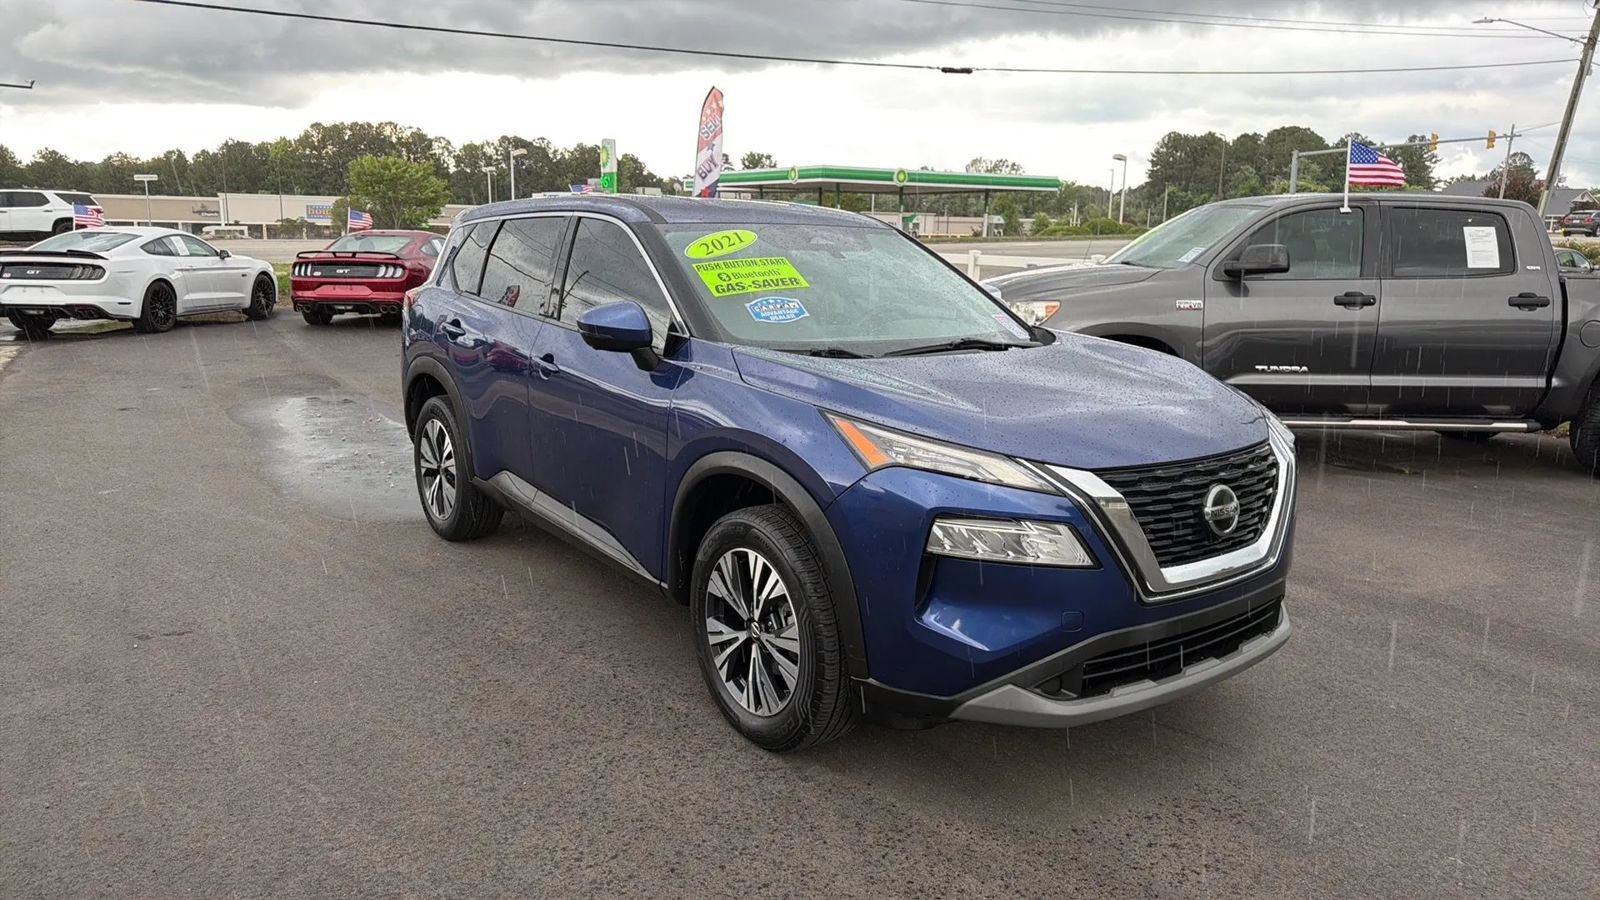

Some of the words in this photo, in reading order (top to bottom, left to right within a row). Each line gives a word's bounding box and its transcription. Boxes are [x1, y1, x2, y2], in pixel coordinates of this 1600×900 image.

[697, 154, 719, 180] BUY
[699, 232, 744, 255] 2021
[696, 263, 721, 273] PUSH
[723, 259, 758, 269] BUTTON
[760, 258, 788, 267] START
[732, 268, 781, 280] Bluetooth
[1255, 365, 1309, 373] TUNDRA
[1211, 502, 1239, 519] NISSAN
